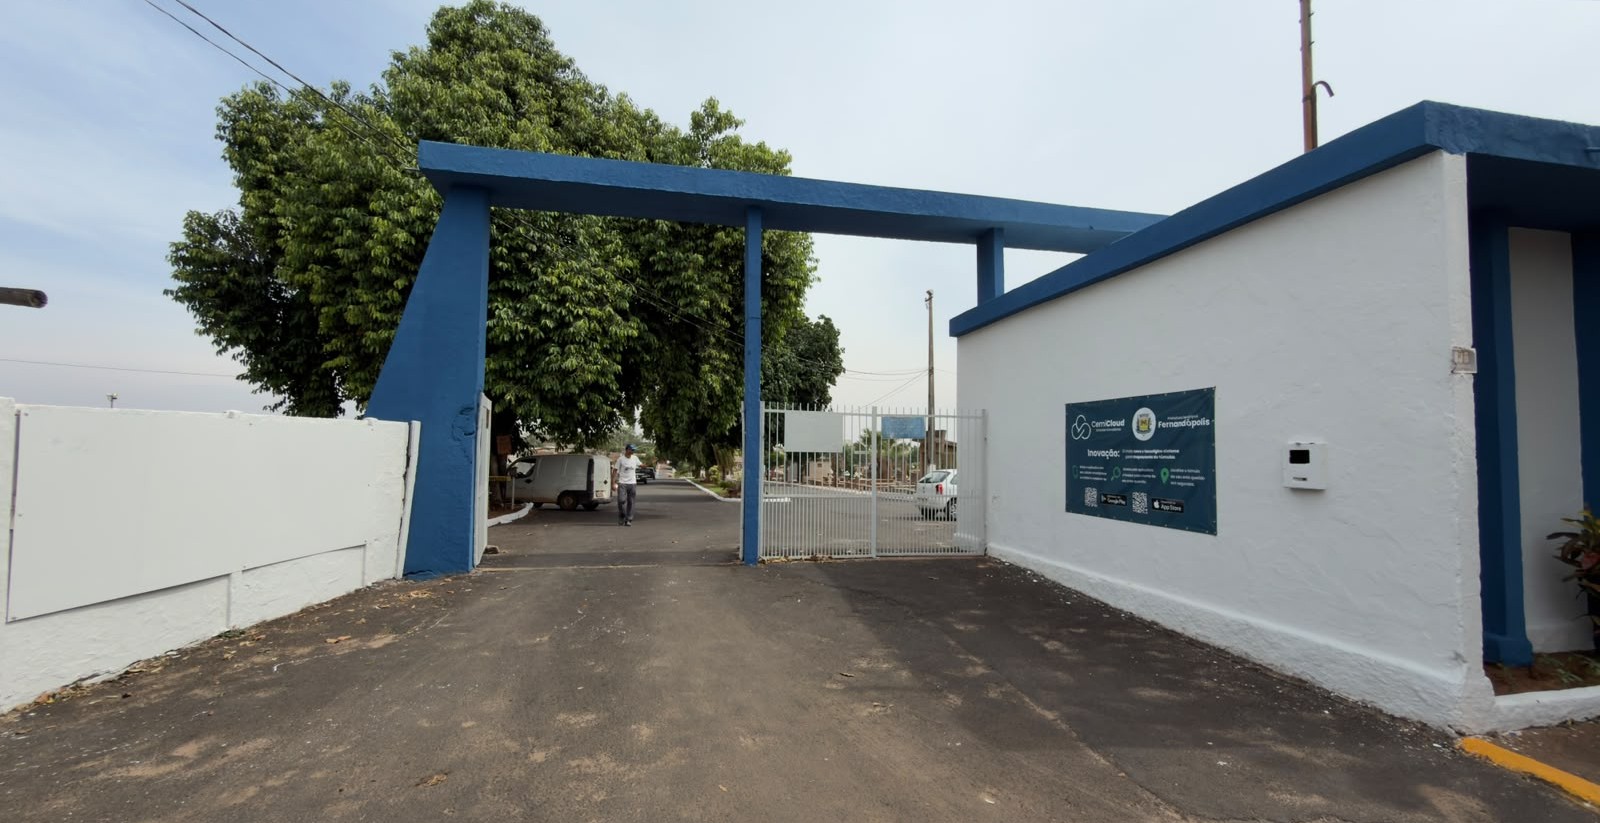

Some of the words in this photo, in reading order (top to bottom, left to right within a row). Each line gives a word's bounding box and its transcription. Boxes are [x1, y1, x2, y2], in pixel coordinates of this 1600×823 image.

[1091, 419, 1125, 428] CemiCloud
[1158, 417, 1210, 429] Fernandópolis
[1087, 449, 1120, 460] Inovação:
[1170, 504, 1182, 512] Store
